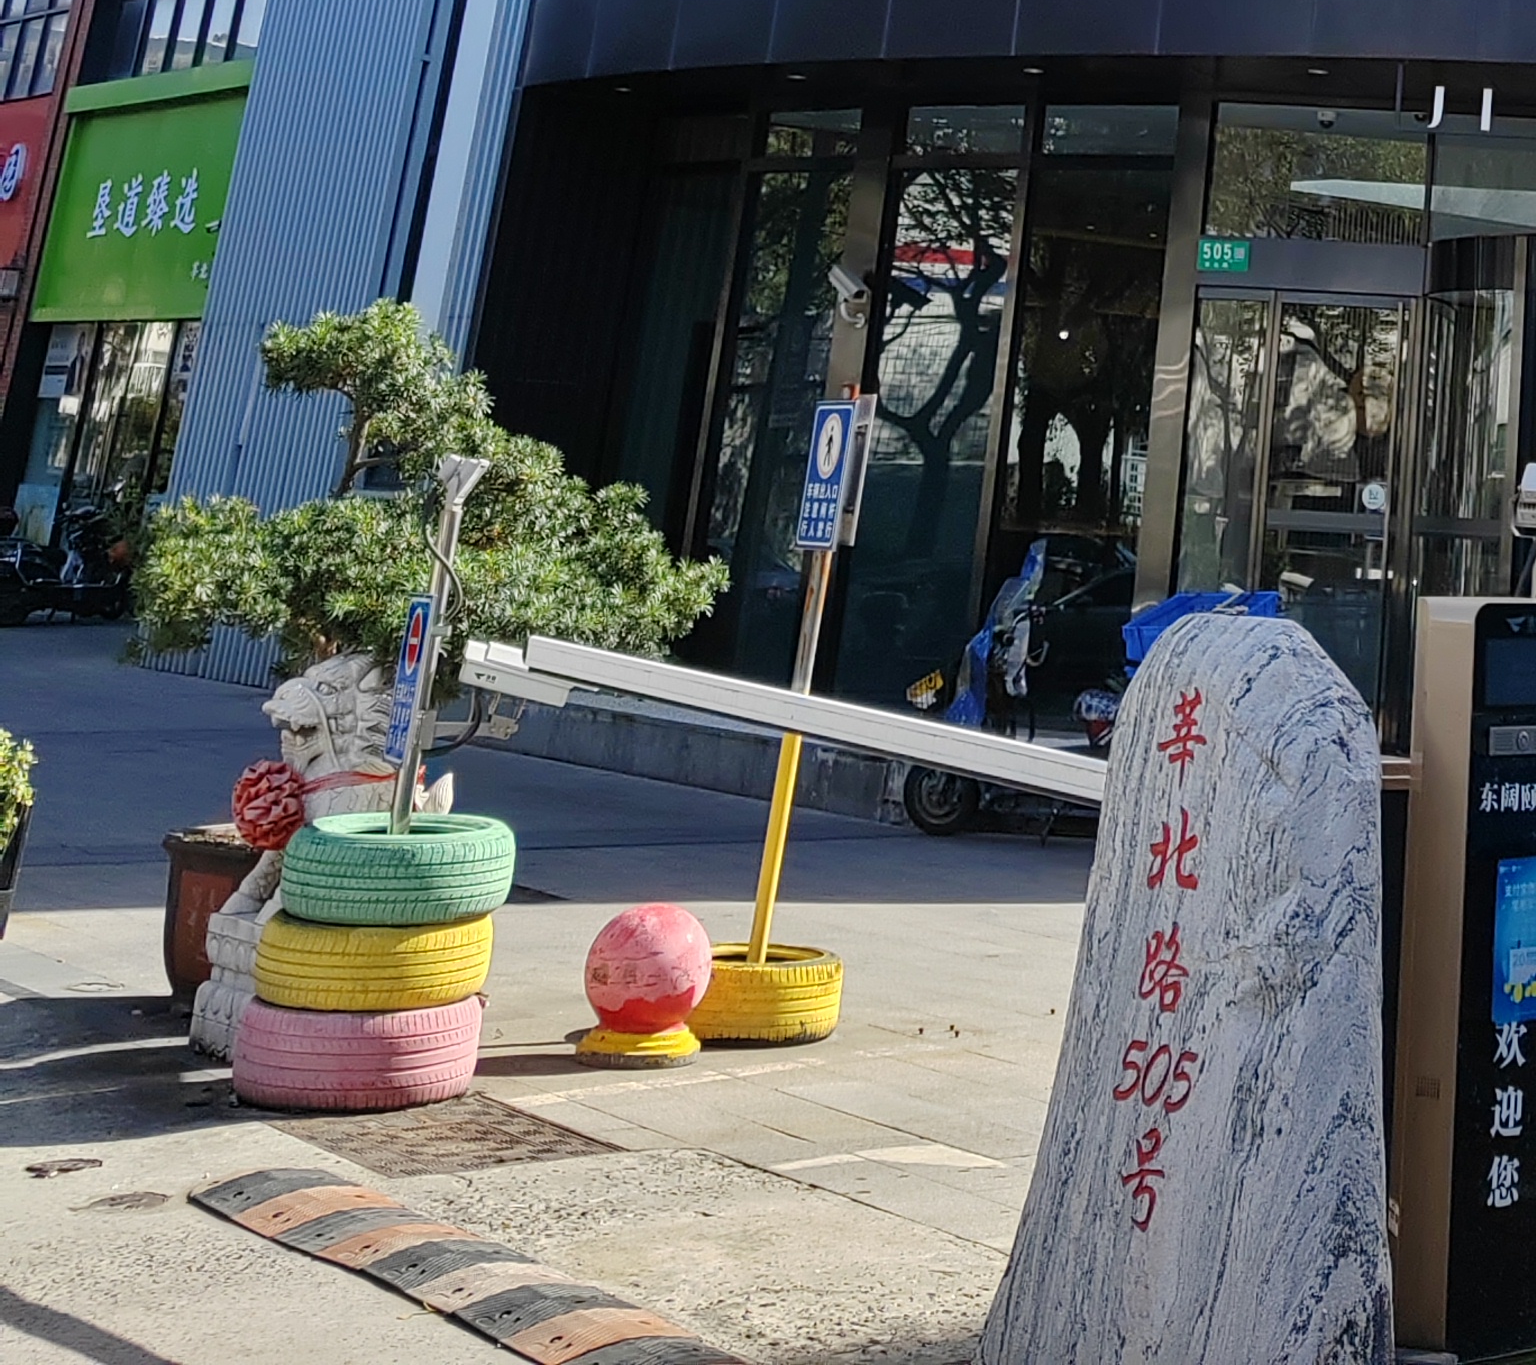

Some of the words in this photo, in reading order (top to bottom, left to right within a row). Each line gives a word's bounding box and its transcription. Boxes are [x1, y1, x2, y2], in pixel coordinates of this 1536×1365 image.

[1427, 85, 1493, 132] JI
[86, 167, 198, 239] 垦道臻选
[1203, 242, 1233, 260] 505
[1487, 1022, 1527, 1209] 欢迎您
